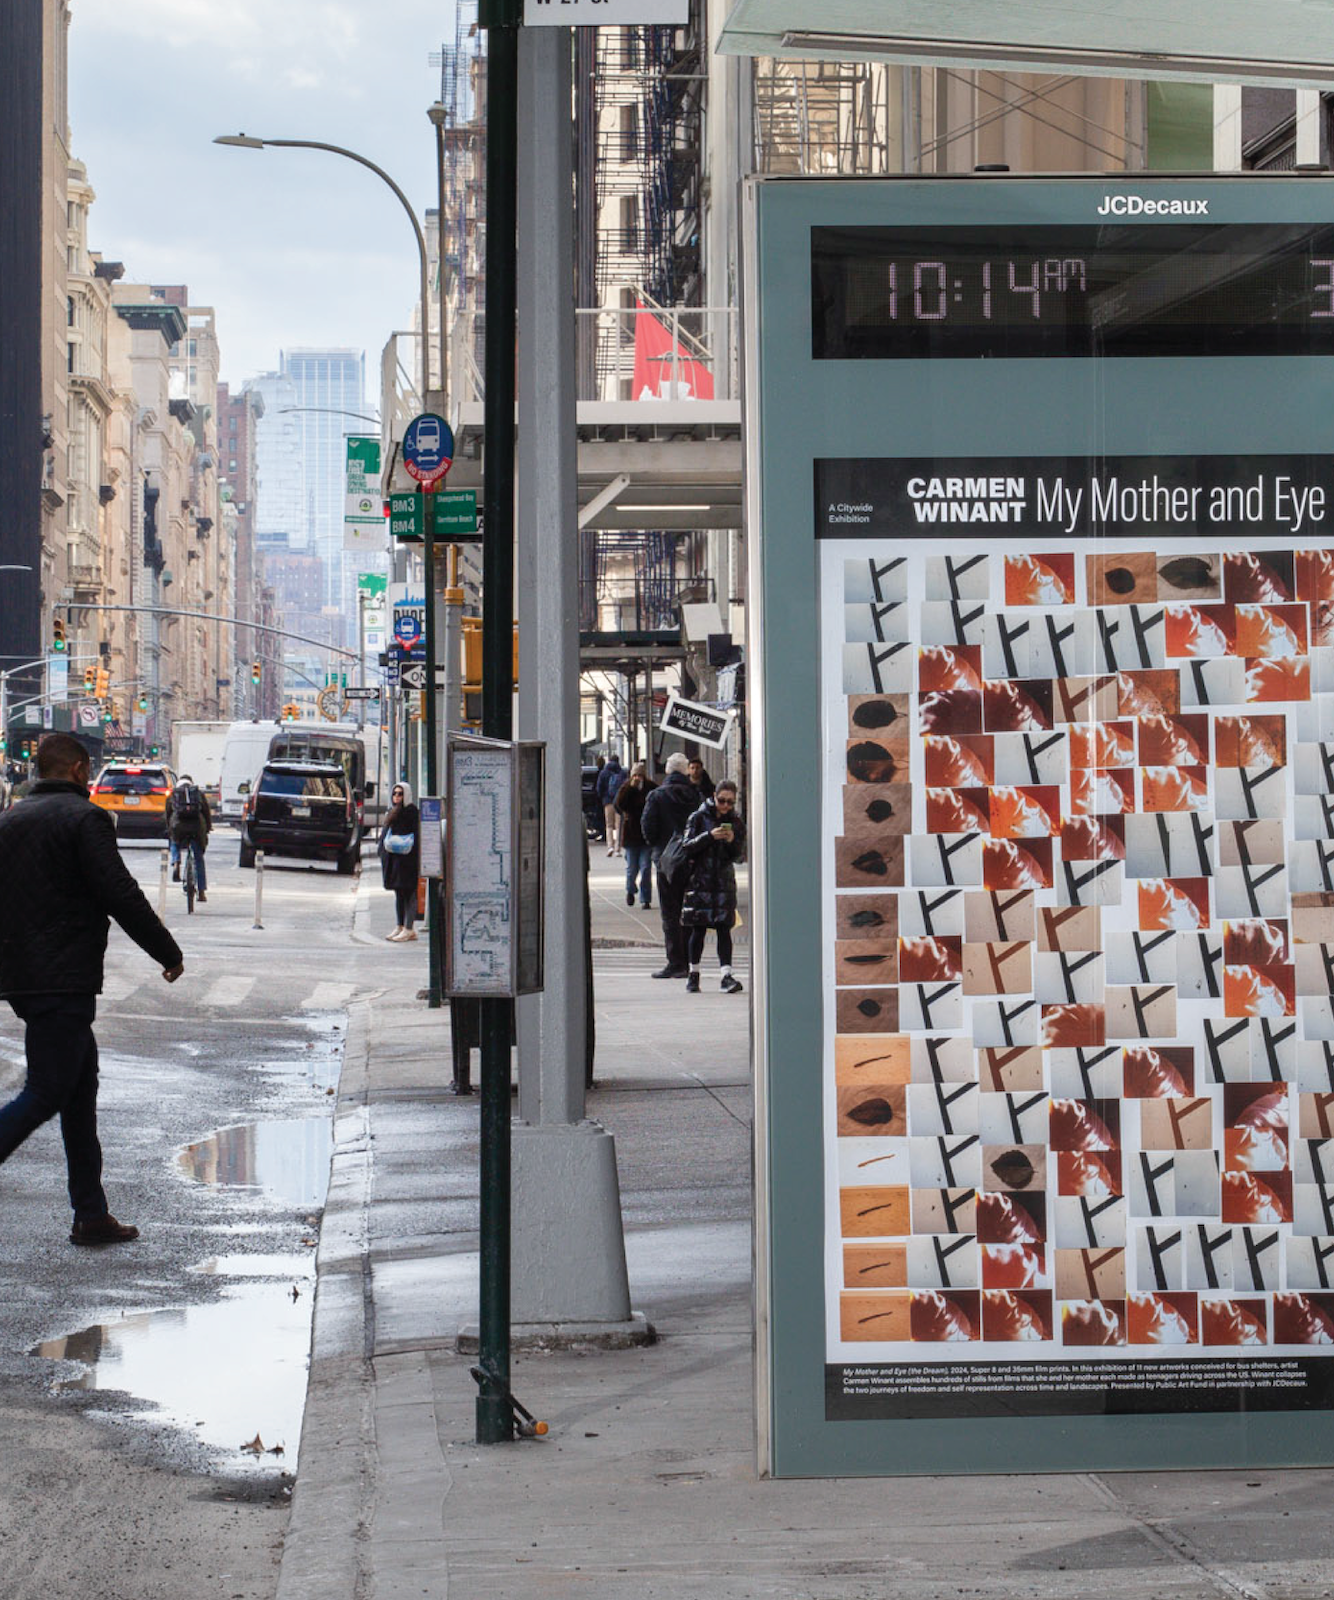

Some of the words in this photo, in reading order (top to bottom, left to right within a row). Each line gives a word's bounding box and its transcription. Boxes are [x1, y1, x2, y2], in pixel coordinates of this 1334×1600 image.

[1097, 196, 1209, 216] JCDecaux
[889, 262, 1041, 320] 10:14
[1044, 259, 1087, 292] AM
[392, 497, 416, 513] BM3
[828, 504, 836, 513] A
[837, 503, 874, 515] Citywide
[906, 477, 1026, 499] CARMEN
[1037, 477, 1083, 533] My
[1091, 474, 1202, 523] Mother
[1209, 474, 1264, 522] and
[1274, 475, 1326, 533] Eye
[913, 500, 1027, 523] WINANT
[392, 517, 416, 533] BM4
[828, 514, 871, 524] Exhibition
[412, 671, 427, 682] ON
[671, 707, 723, 733] MEMORIES
